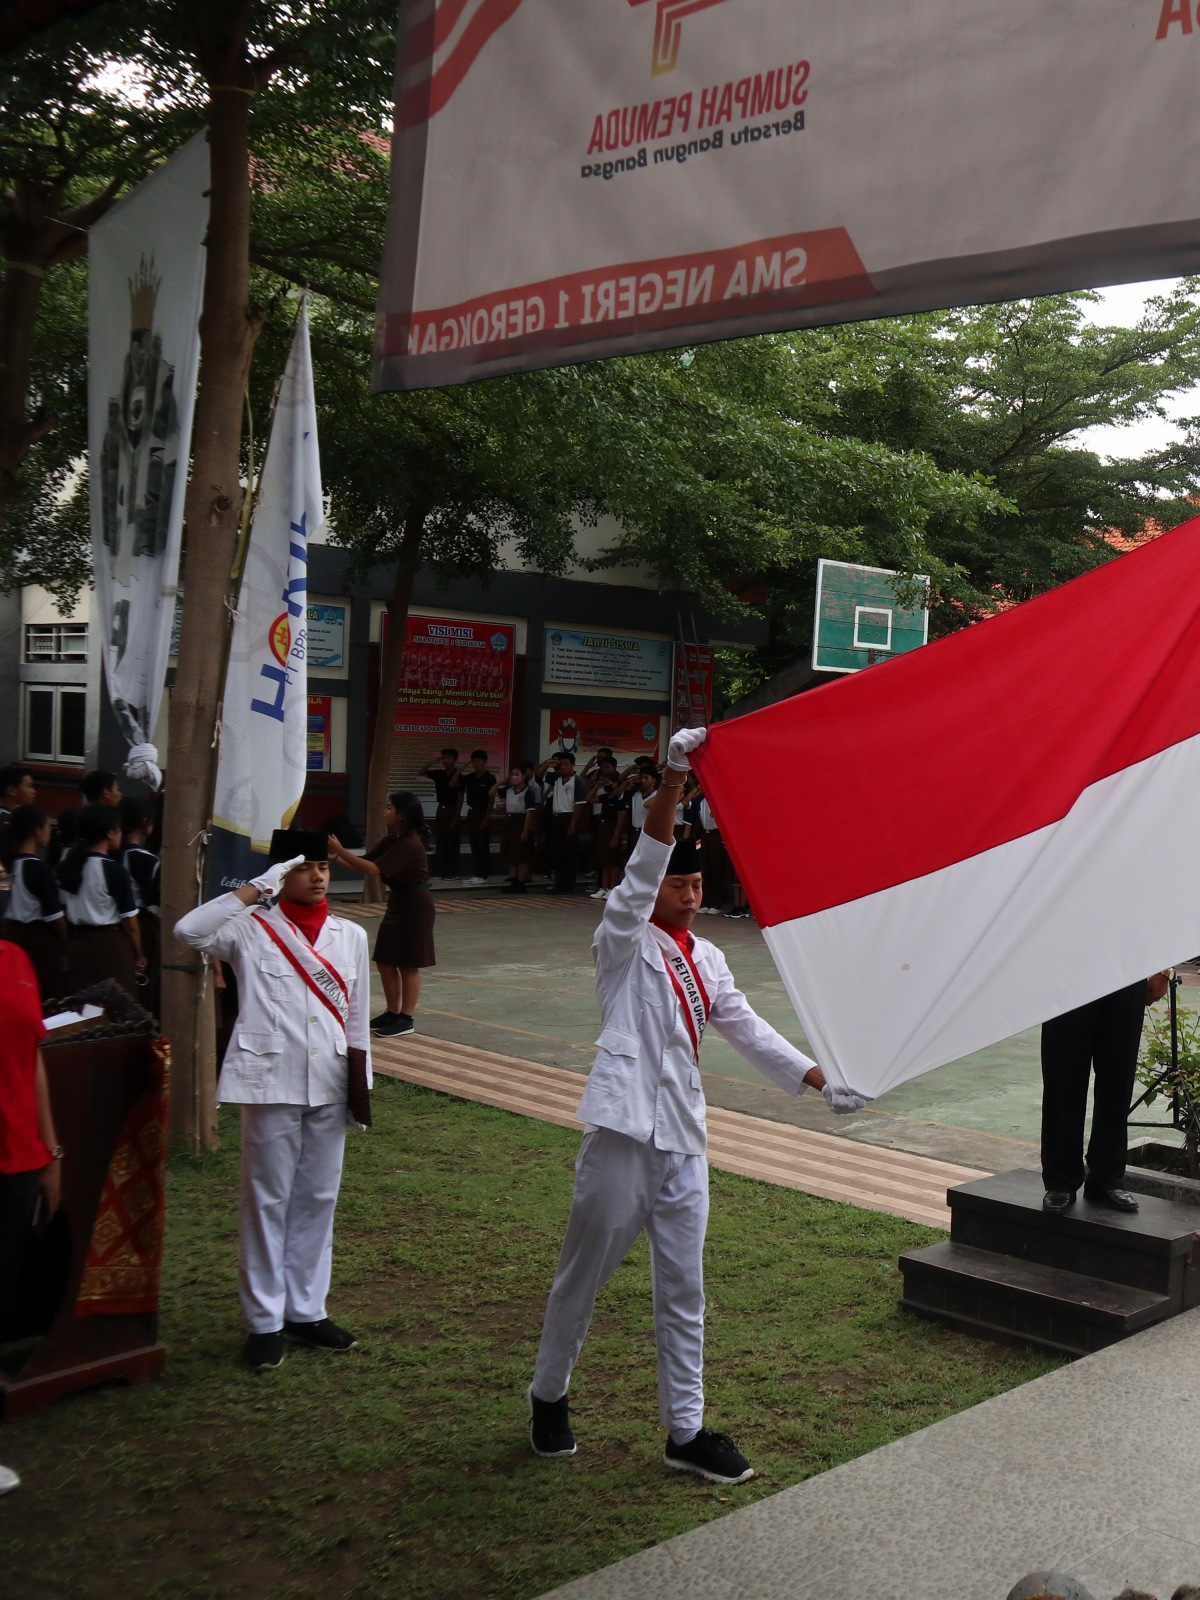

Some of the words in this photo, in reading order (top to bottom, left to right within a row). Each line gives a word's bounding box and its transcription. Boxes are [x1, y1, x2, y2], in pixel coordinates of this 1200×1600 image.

[428, 625, 449, 636] VISI
[450, 626, 473, 639] MISI
[582, 636, 609, 648] JANJI
[609, 638, 640, 651] SISWA
[409, 697, 441, 705] Berprofil
[442, 698, 467, 707] Pelajar
[468, 700, 500, 708] Pancasila
[439, 717, 456, 725] MISI
[671, 956, 699, 1004] PETUGAS
